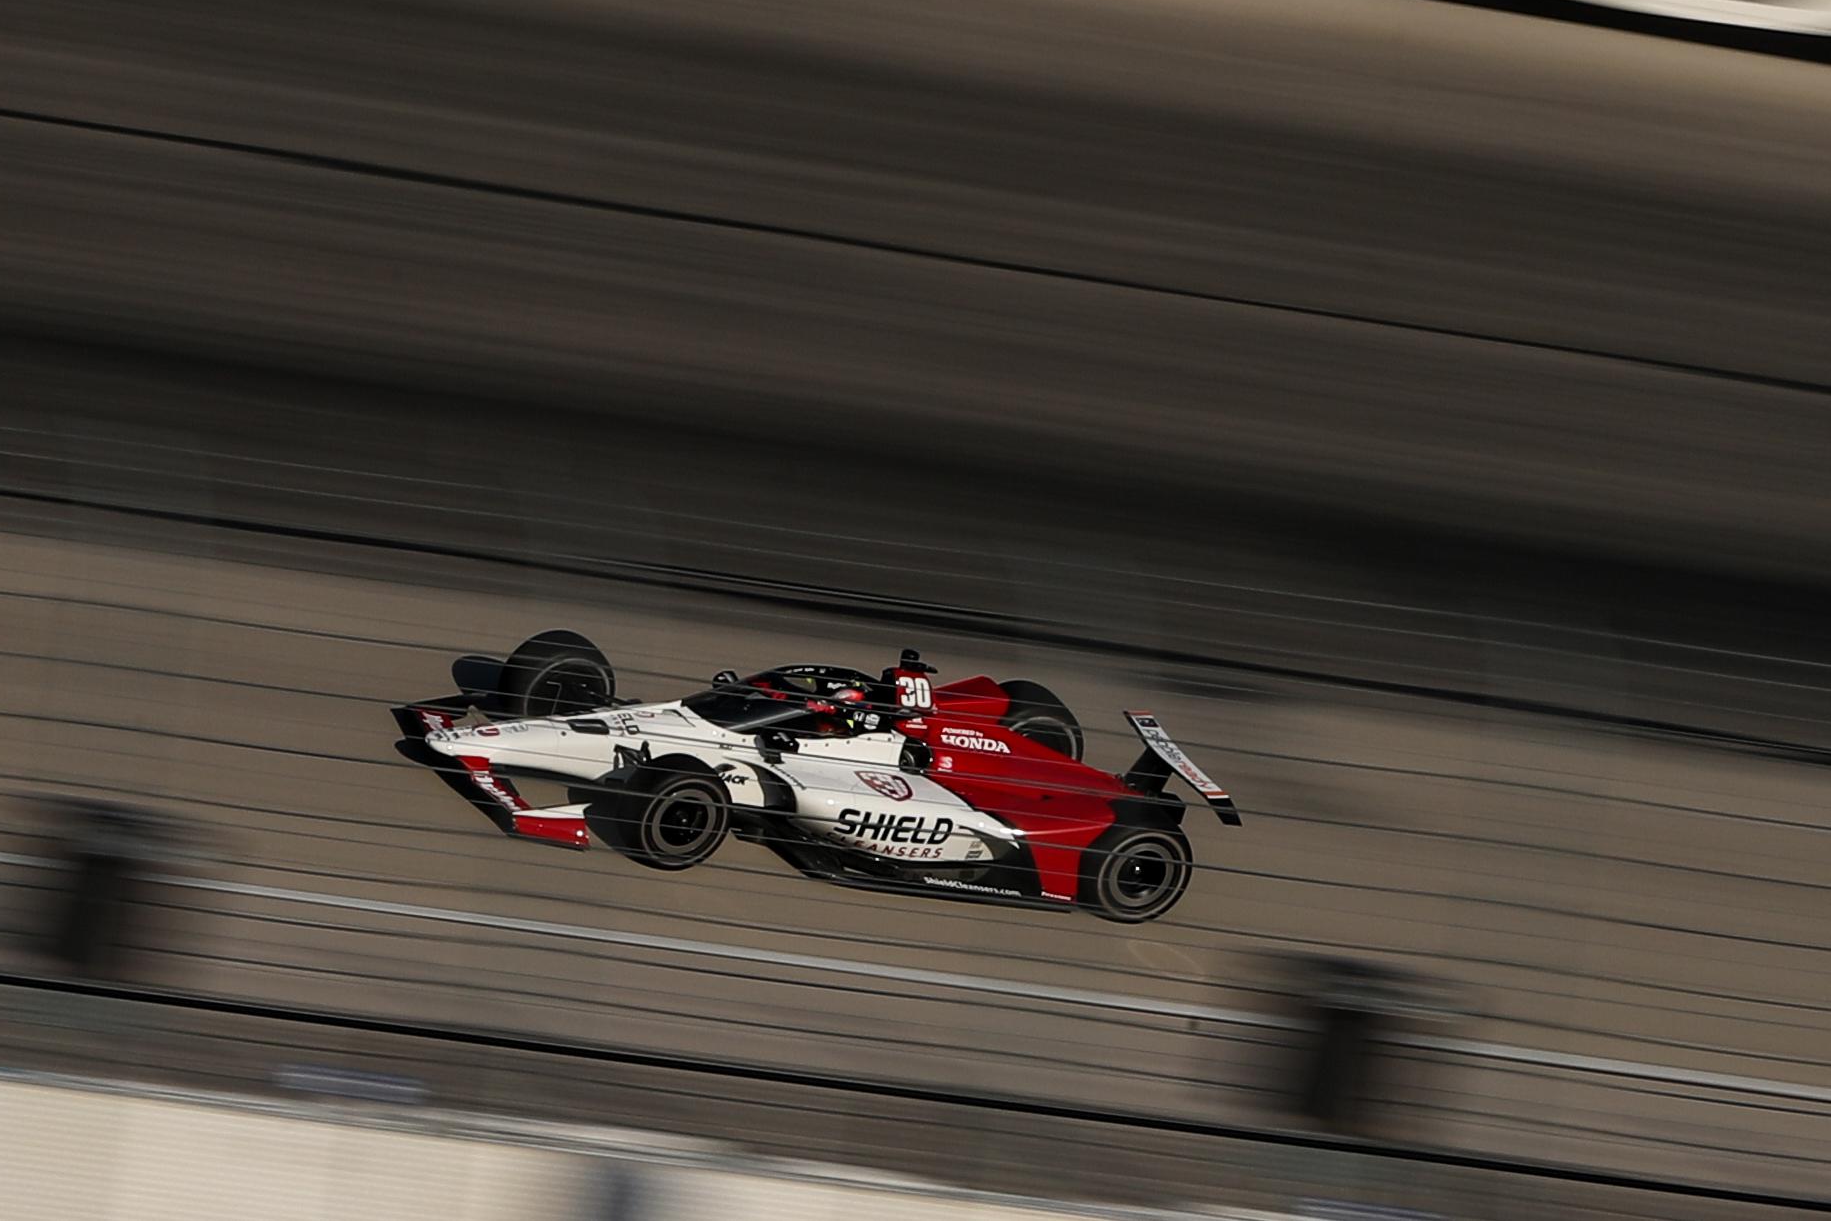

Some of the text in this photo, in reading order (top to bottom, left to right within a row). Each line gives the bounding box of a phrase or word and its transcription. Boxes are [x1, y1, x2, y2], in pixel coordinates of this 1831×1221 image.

[899, 676, 932, 709] 30
[940, 734, 1011, 754] HONDA
[833, 807, 954, 845] SHIELD
